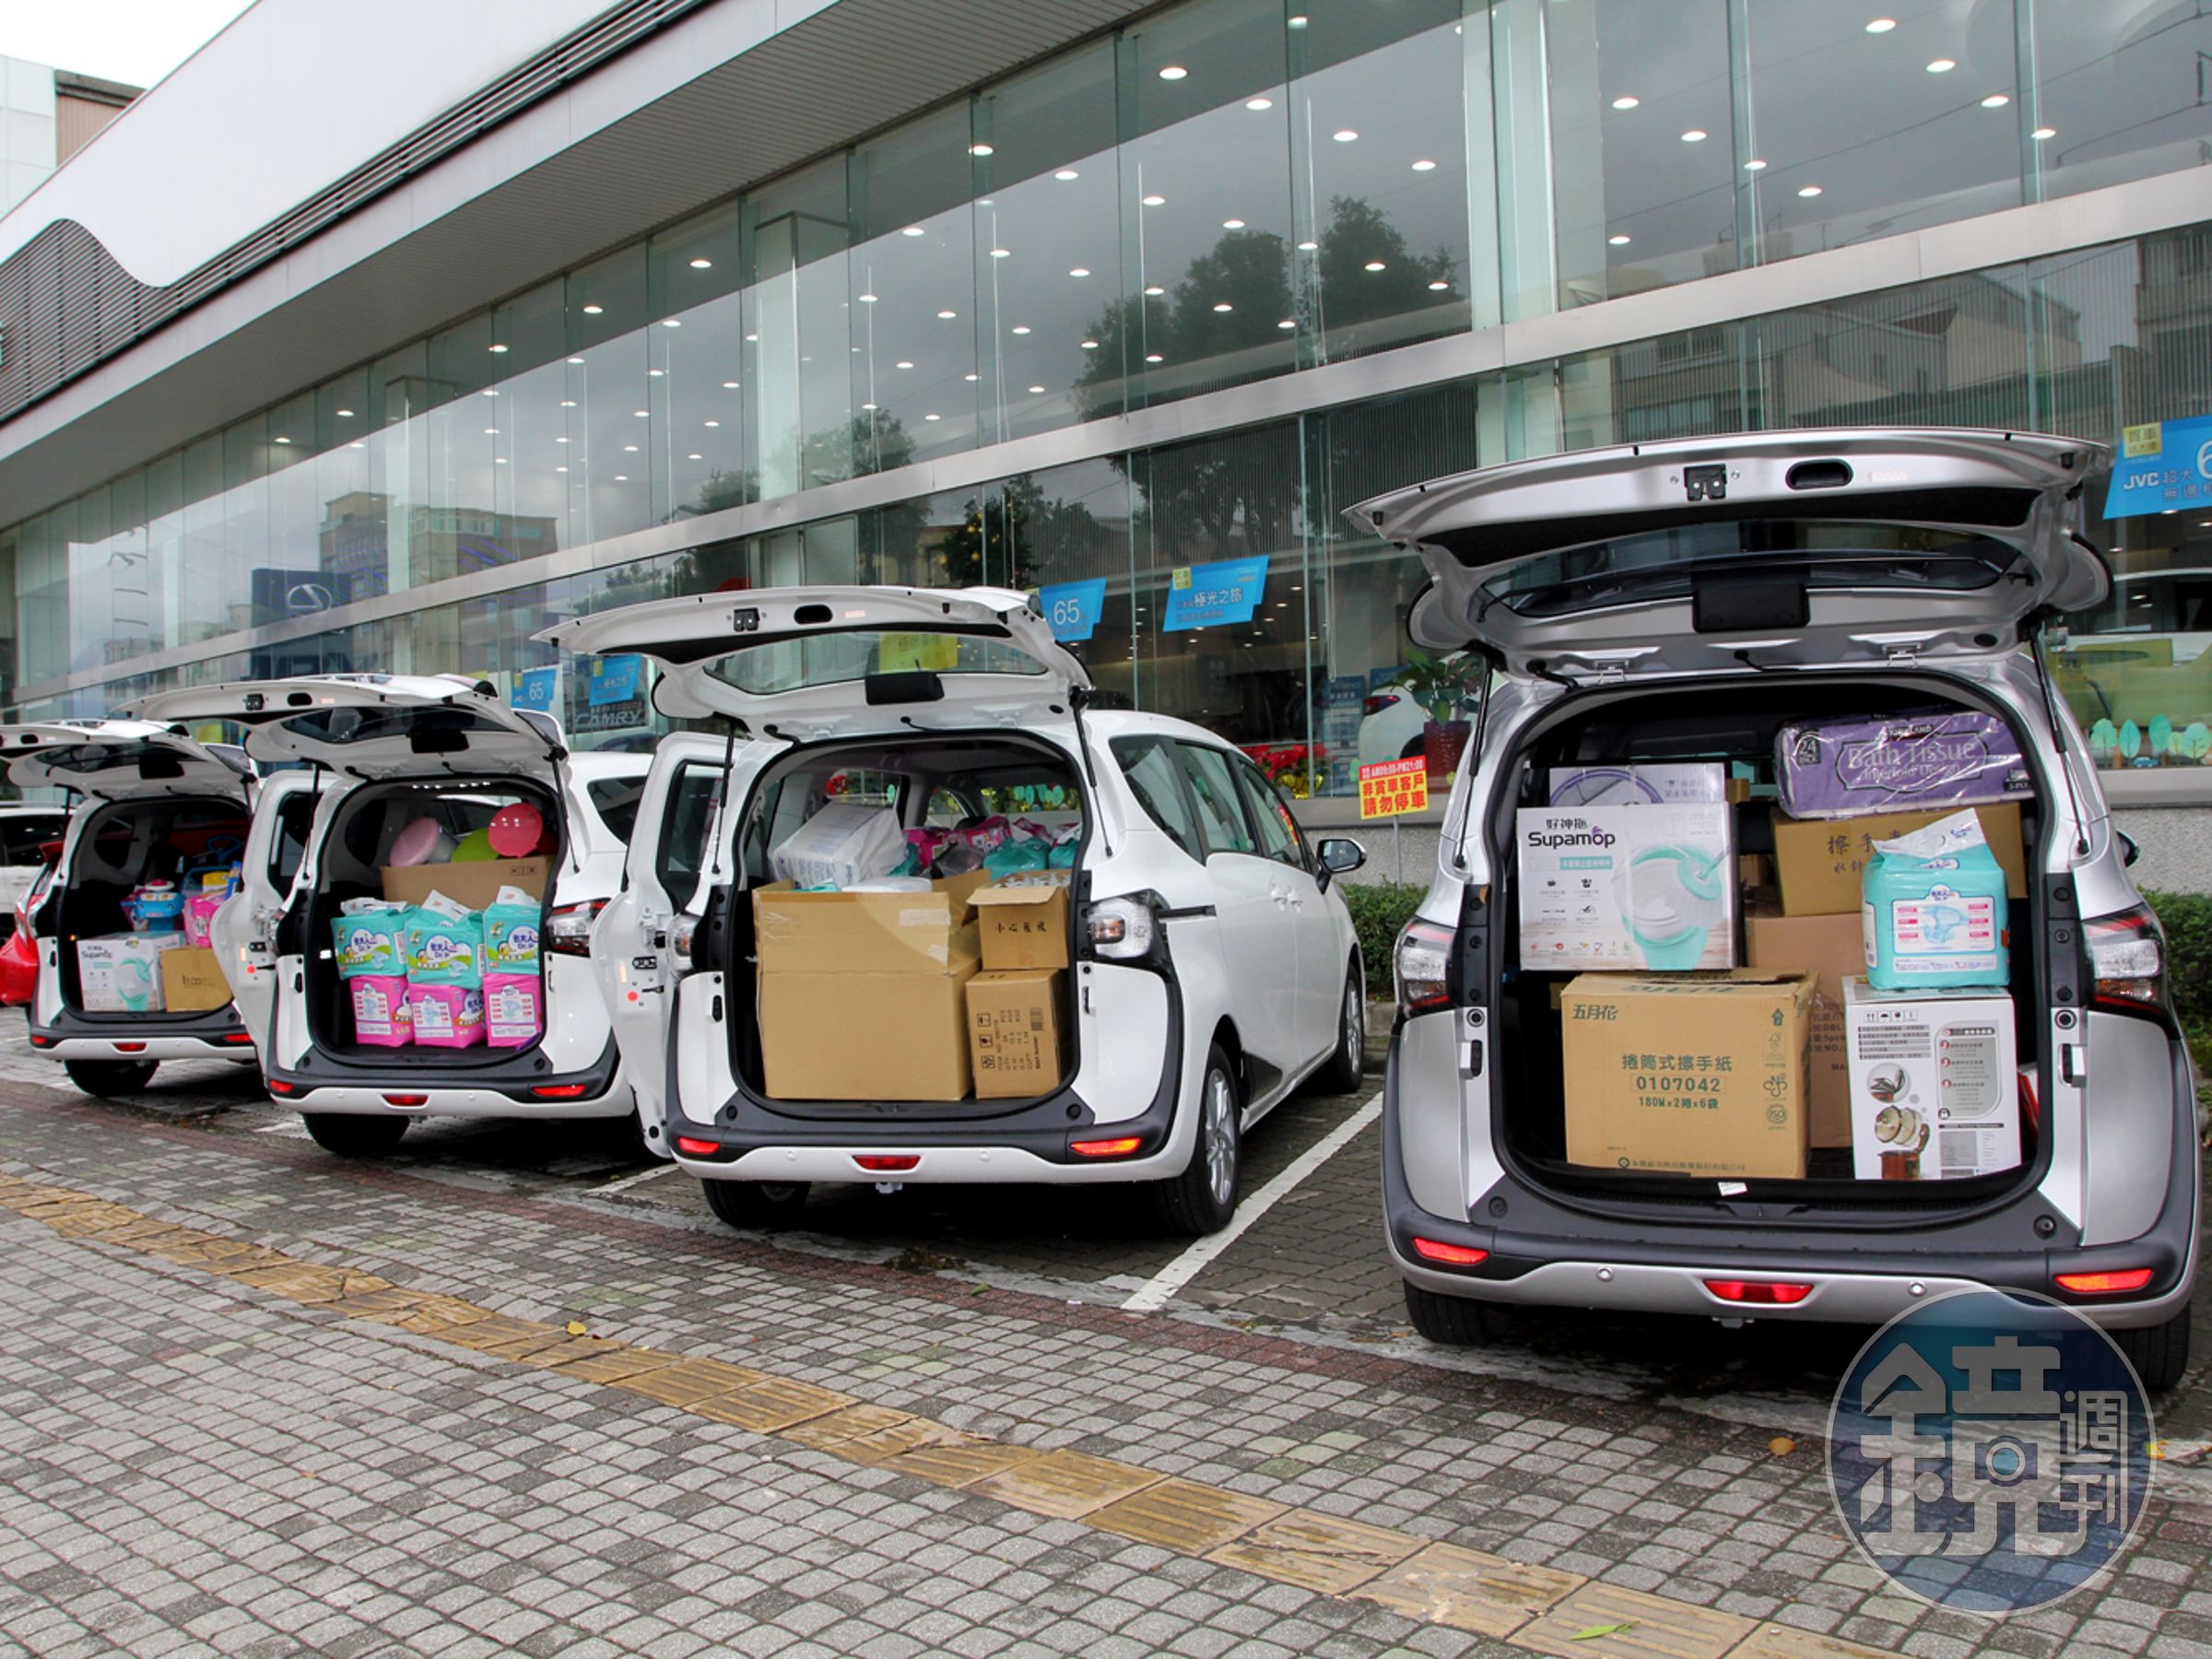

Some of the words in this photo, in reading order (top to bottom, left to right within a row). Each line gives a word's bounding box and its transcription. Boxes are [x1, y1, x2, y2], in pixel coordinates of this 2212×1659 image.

[2123, 472, 2159, 490] JVC
[1053, 598, 1079, 626] 65
[529, 682, 544, 701] 65
[1847, 746, 1900, 770] Bath
[1904, 741, 1976, 764] Tissue
[1363, 790, 1426, 817] 請勿停車
[1546, 818, 1588, 830] 好神拖
[1528, 828, 1616, 849] Supamop
[1572, 1003, 1618, 1021] 五月花
[1622, 1053, 1733, 1072] 捲筒式擦手紙
[1636, 1077, 1722, 1092] 0107042
